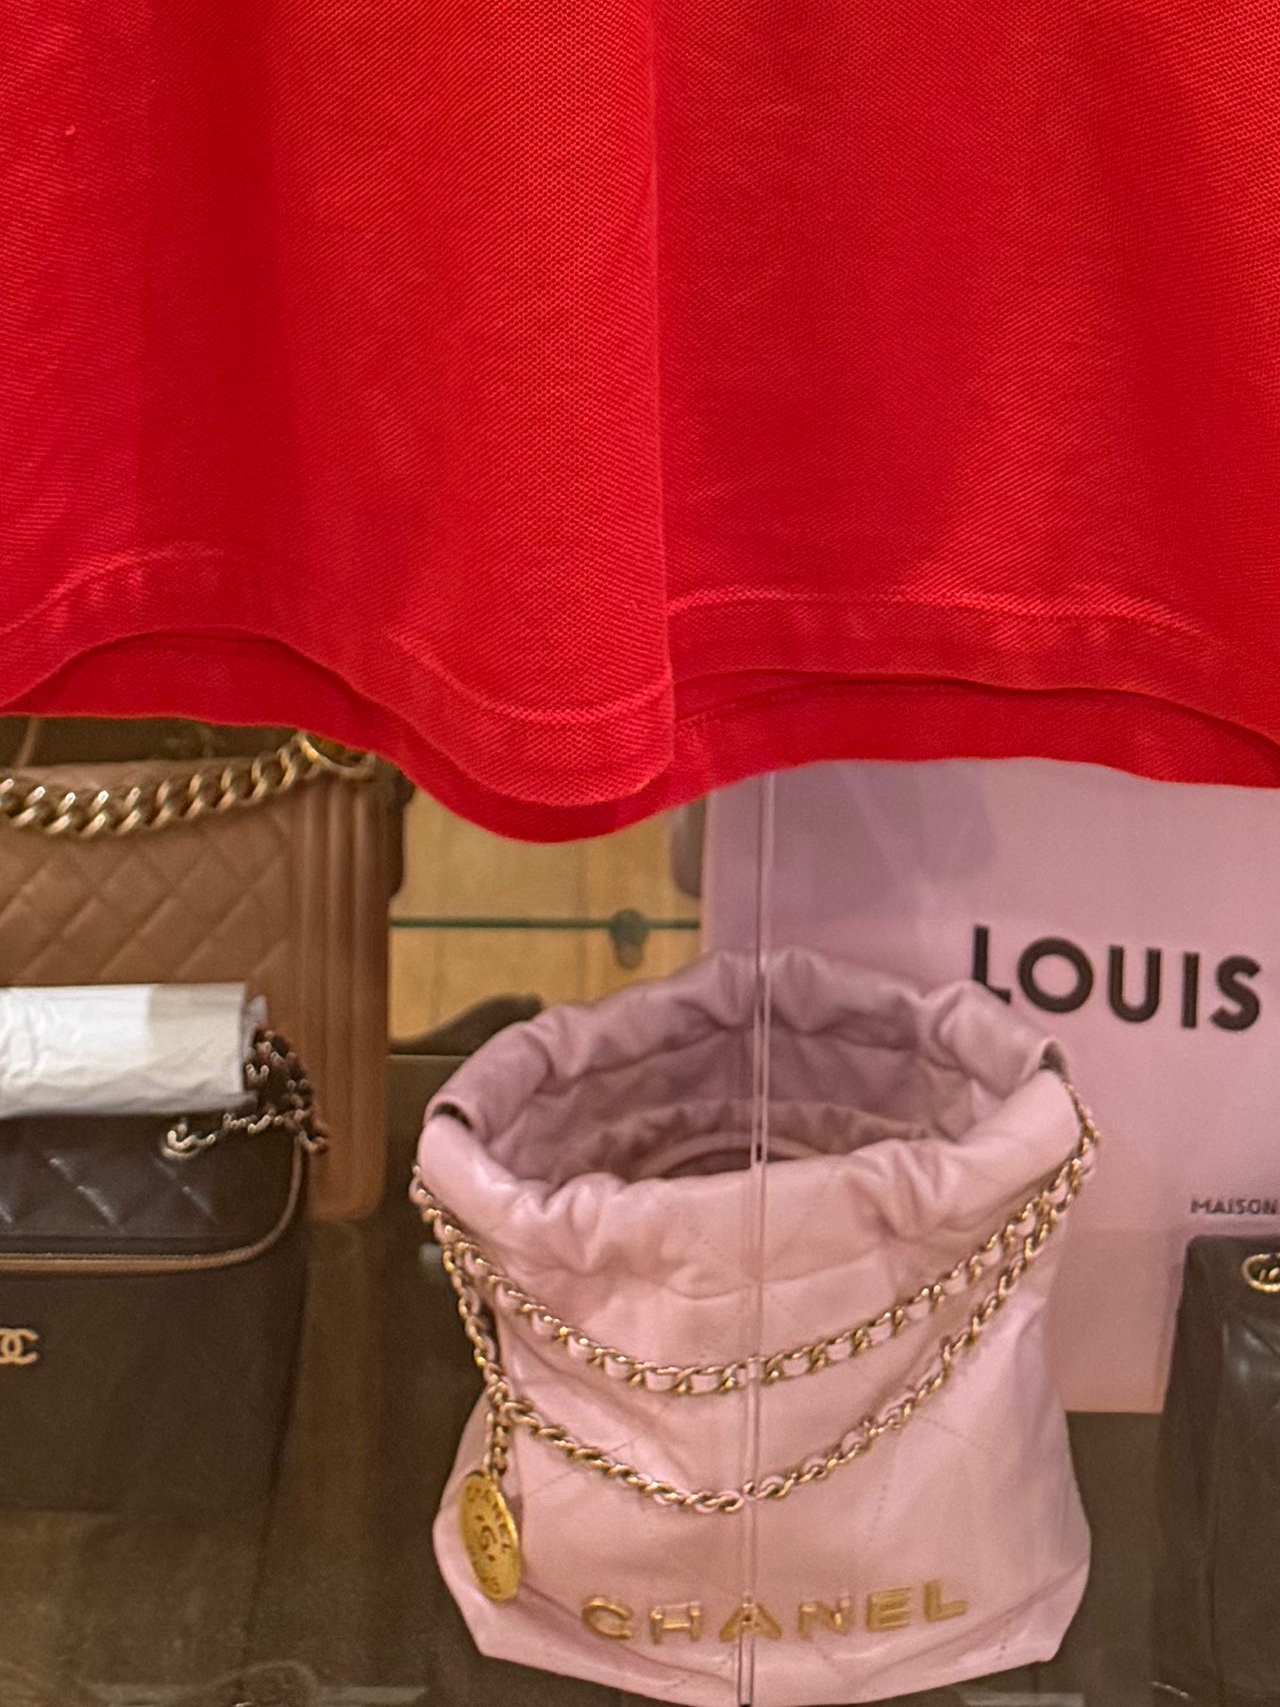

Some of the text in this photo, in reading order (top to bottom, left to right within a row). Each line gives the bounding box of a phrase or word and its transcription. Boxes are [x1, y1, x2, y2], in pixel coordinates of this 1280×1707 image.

[972, 925, 1262, 1032] LOUIS
[1190, 1198, 1278, 1215] MAISON
[581, 1580, 968, 1644] CHANEL
